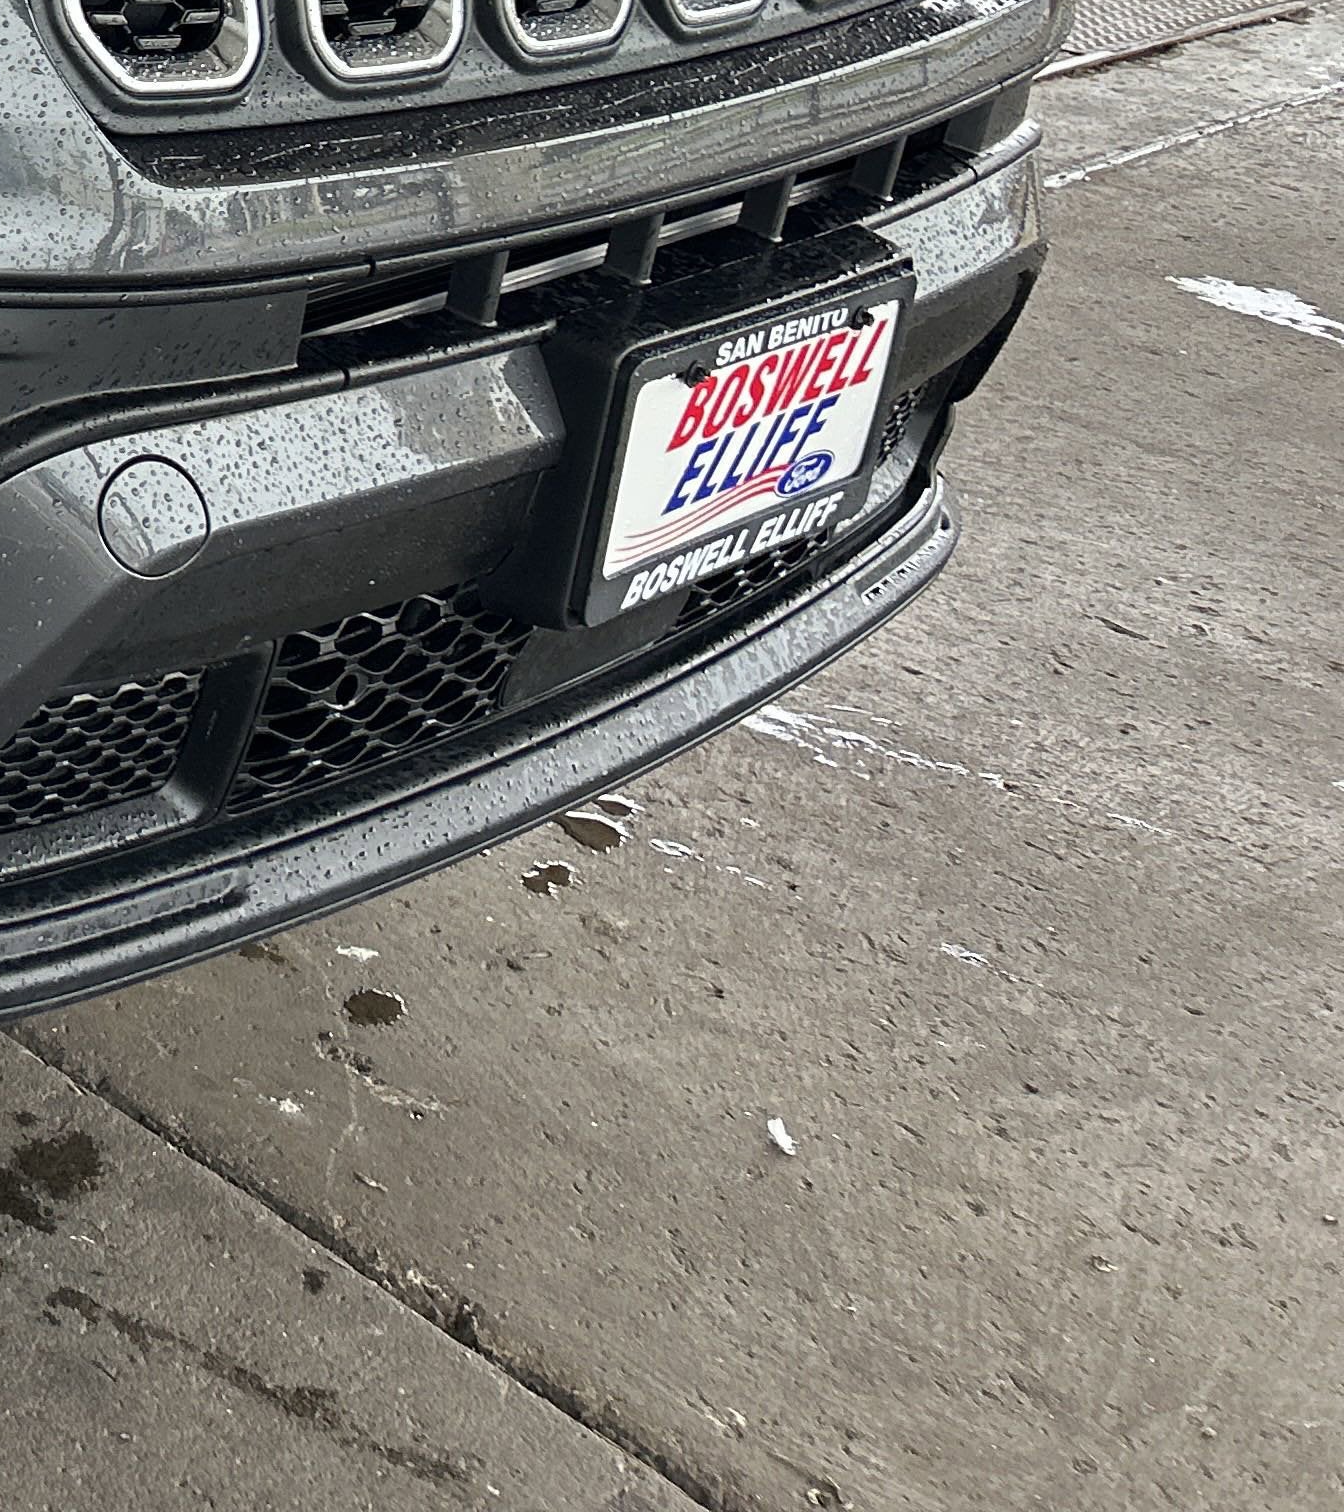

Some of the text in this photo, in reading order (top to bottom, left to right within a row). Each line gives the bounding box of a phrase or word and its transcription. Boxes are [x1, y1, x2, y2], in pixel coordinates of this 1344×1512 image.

[665, 318, 889, 453] BOSWELL
[715, 307, 849, 366] SAN BENITO
[660, 393, 842, 516] ELLIFF
[784, 457, 826, 493] Ford
[620, 491, 845, 610] BOSWELL ELLIFF
